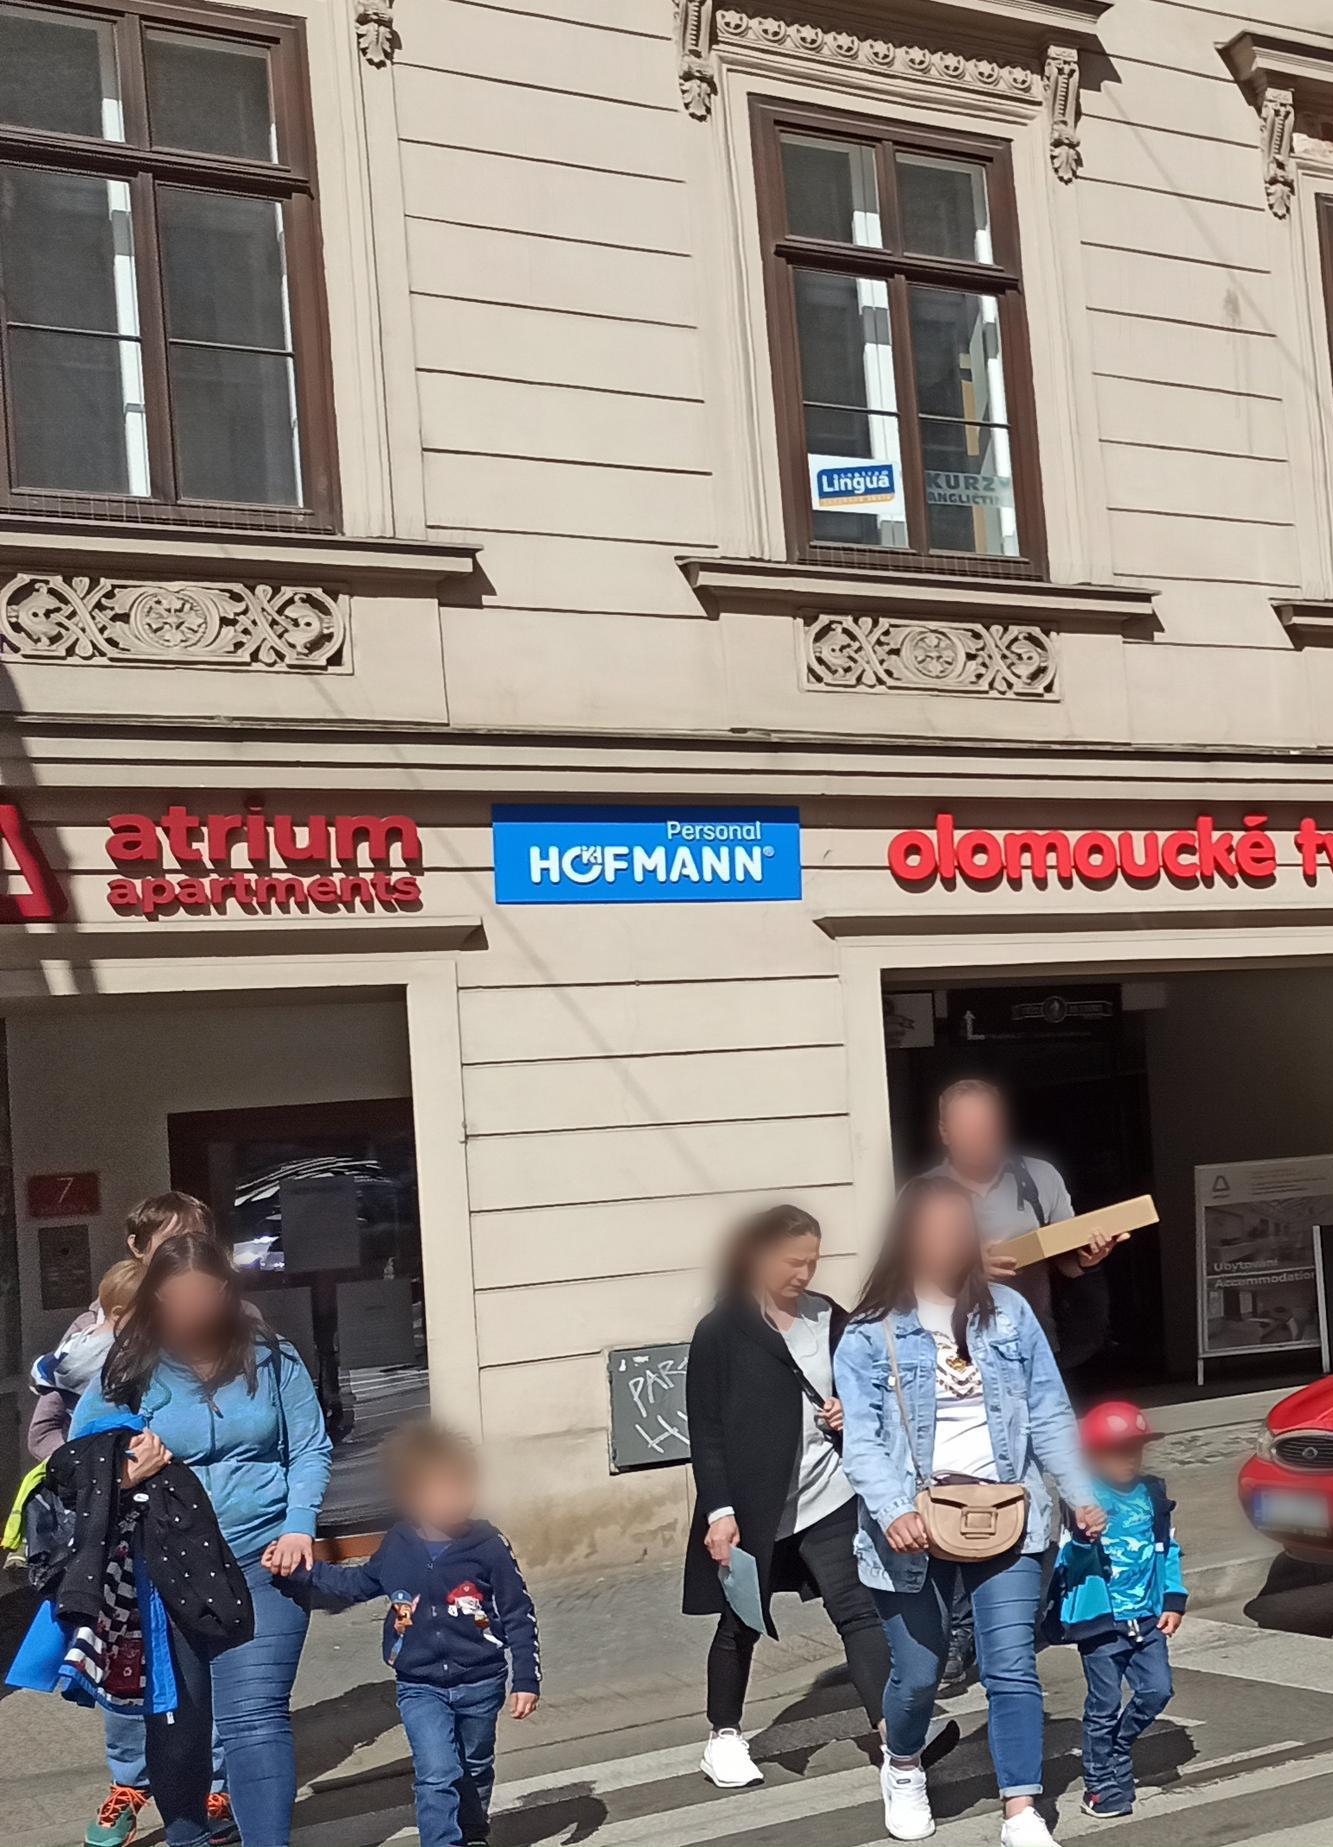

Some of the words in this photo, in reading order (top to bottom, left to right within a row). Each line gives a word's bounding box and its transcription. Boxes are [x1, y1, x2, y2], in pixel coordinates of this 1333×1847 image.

[106, 805, 420, 861] atrium
[667, 820, 761, 841] Personal
[888, 813, 1276, 881] olomoucké
[107, 872, 421, 912] apartments
[56, 1176, 74, 1204] 7
